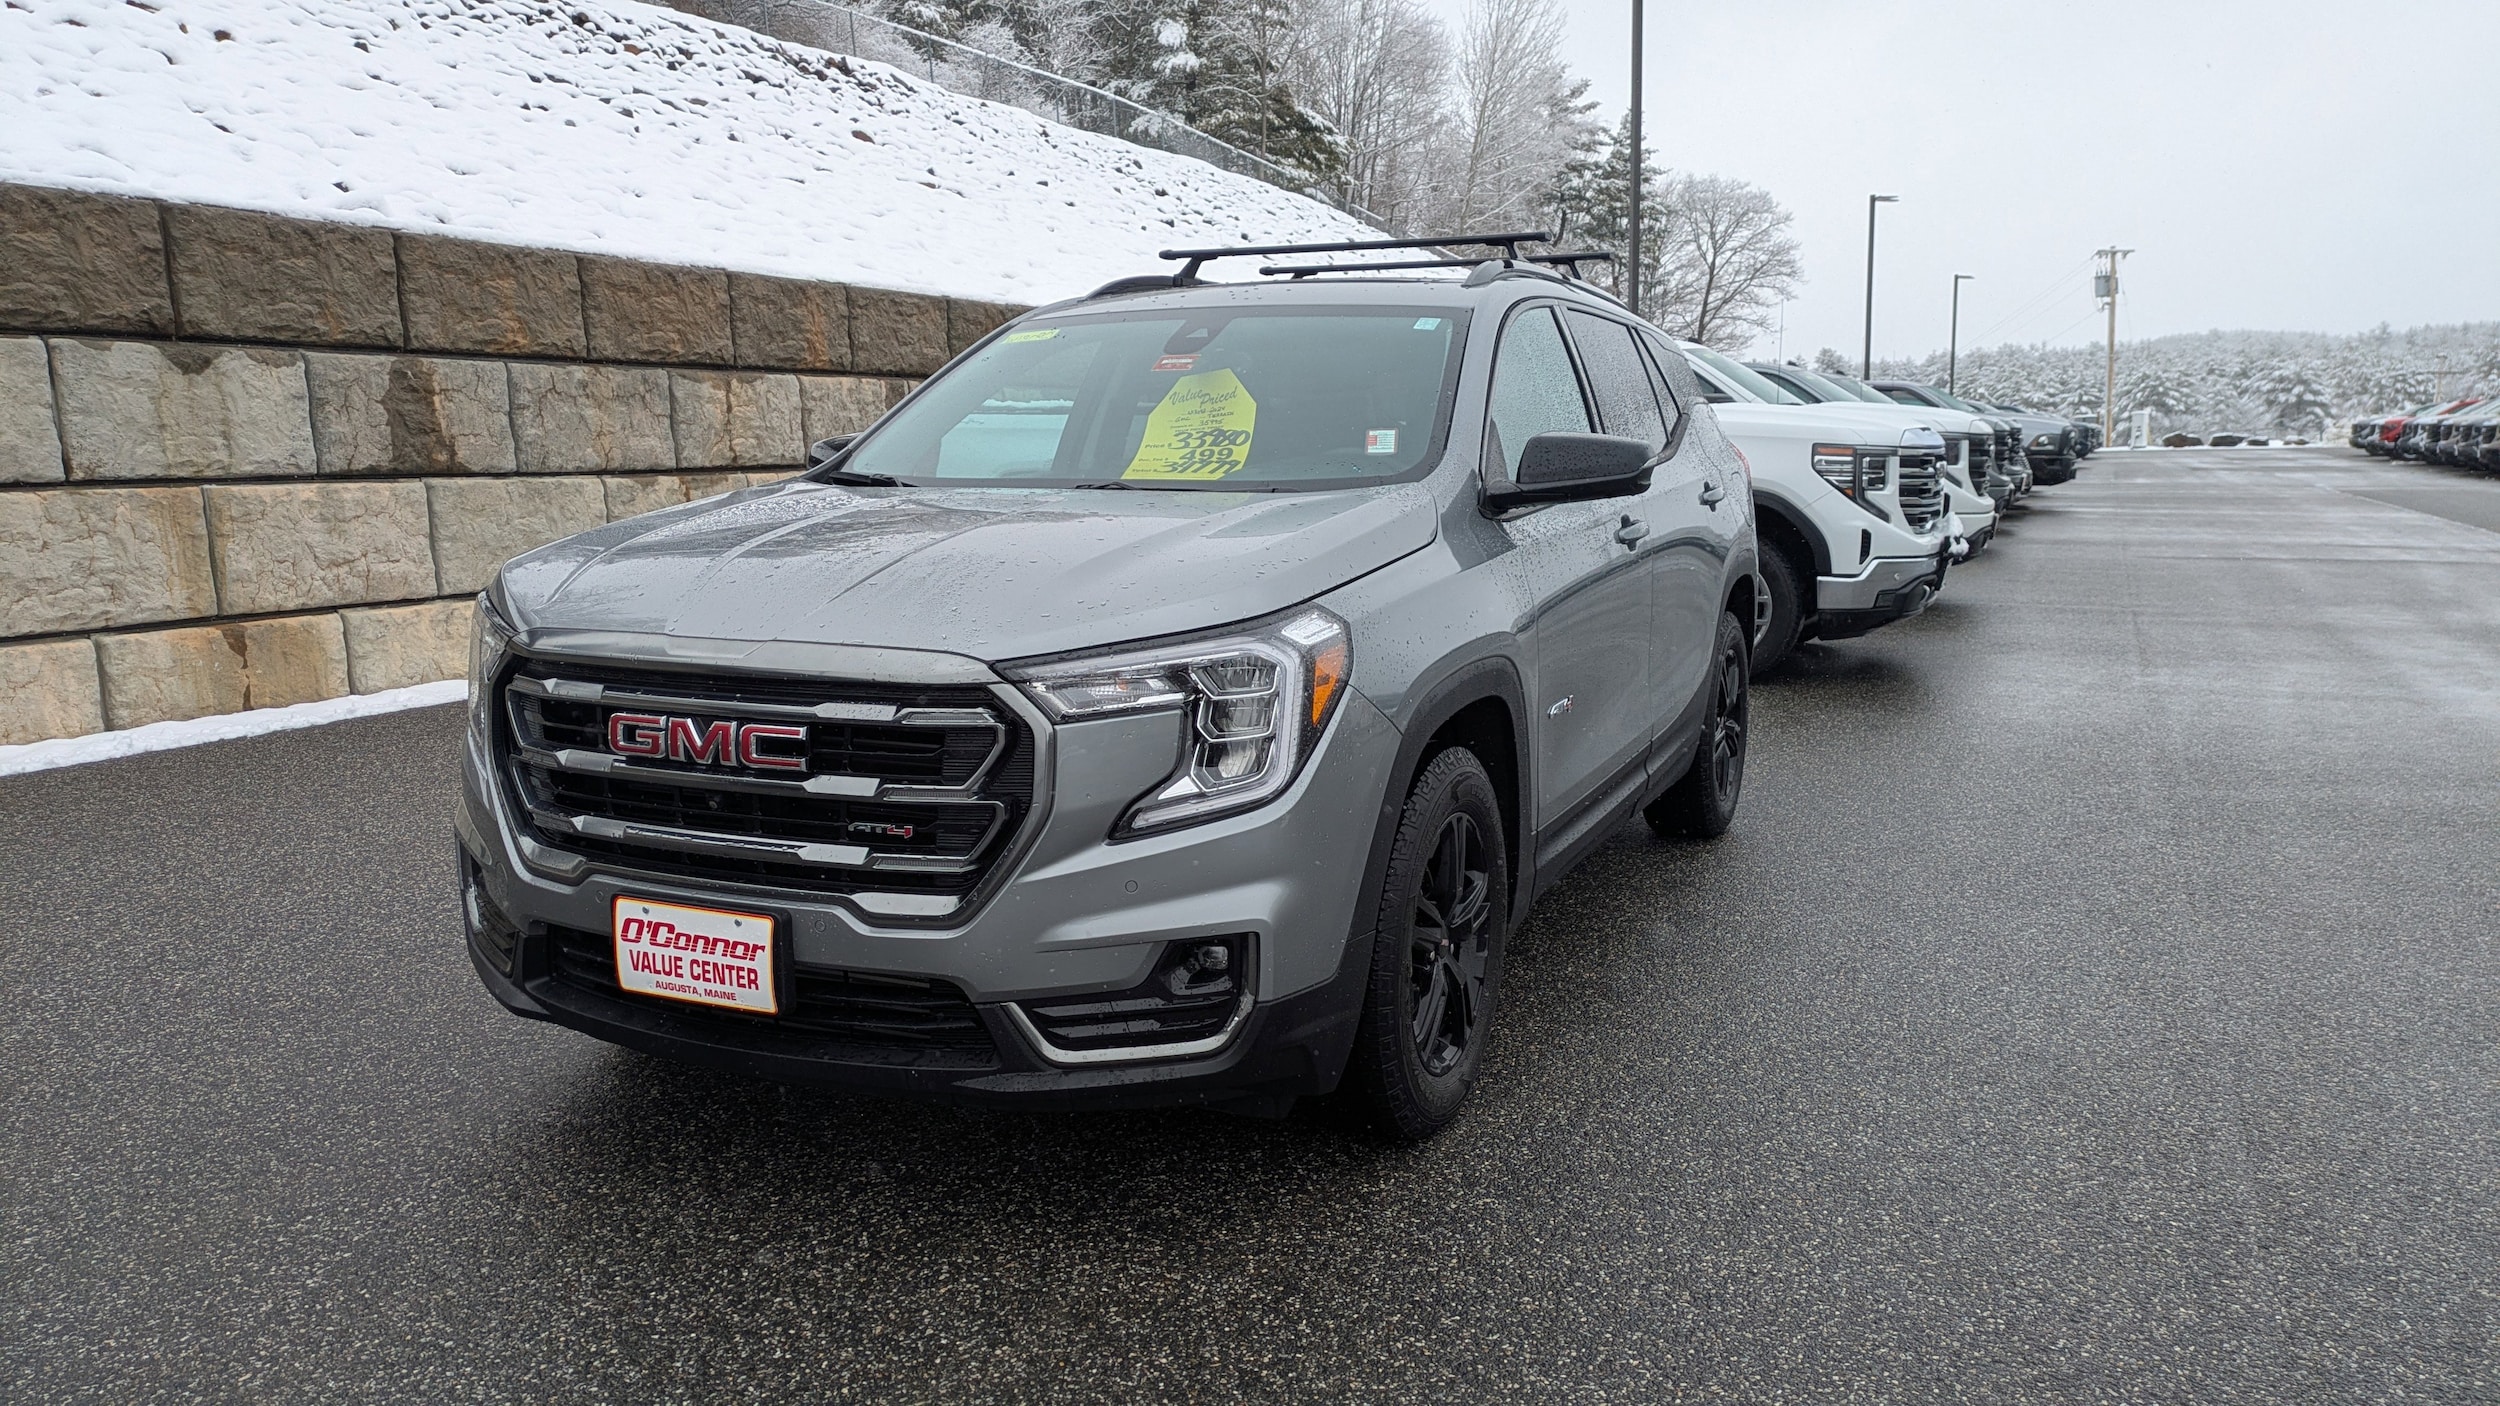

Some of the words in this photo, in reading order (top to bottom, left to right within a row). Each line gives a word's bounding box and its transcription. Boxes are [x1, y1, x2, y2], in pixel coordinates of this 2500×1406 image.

[1169, 389, 1203, 406] Value
[1200, 386, 1238, 408] Priced
[1178, 447, 1234, 461] 499
[608, 712, 811, 773] GMC
[847, 821, 914, 840] AT4
[620, 917, 766, 962] O'Connor
[629, 949, 684, 979] VALUE
[689, 958, 760, 991] CENTER
[655, 980, 702, 998] AUGUSTA,
[704, 988, 737, 1001] MAINE
